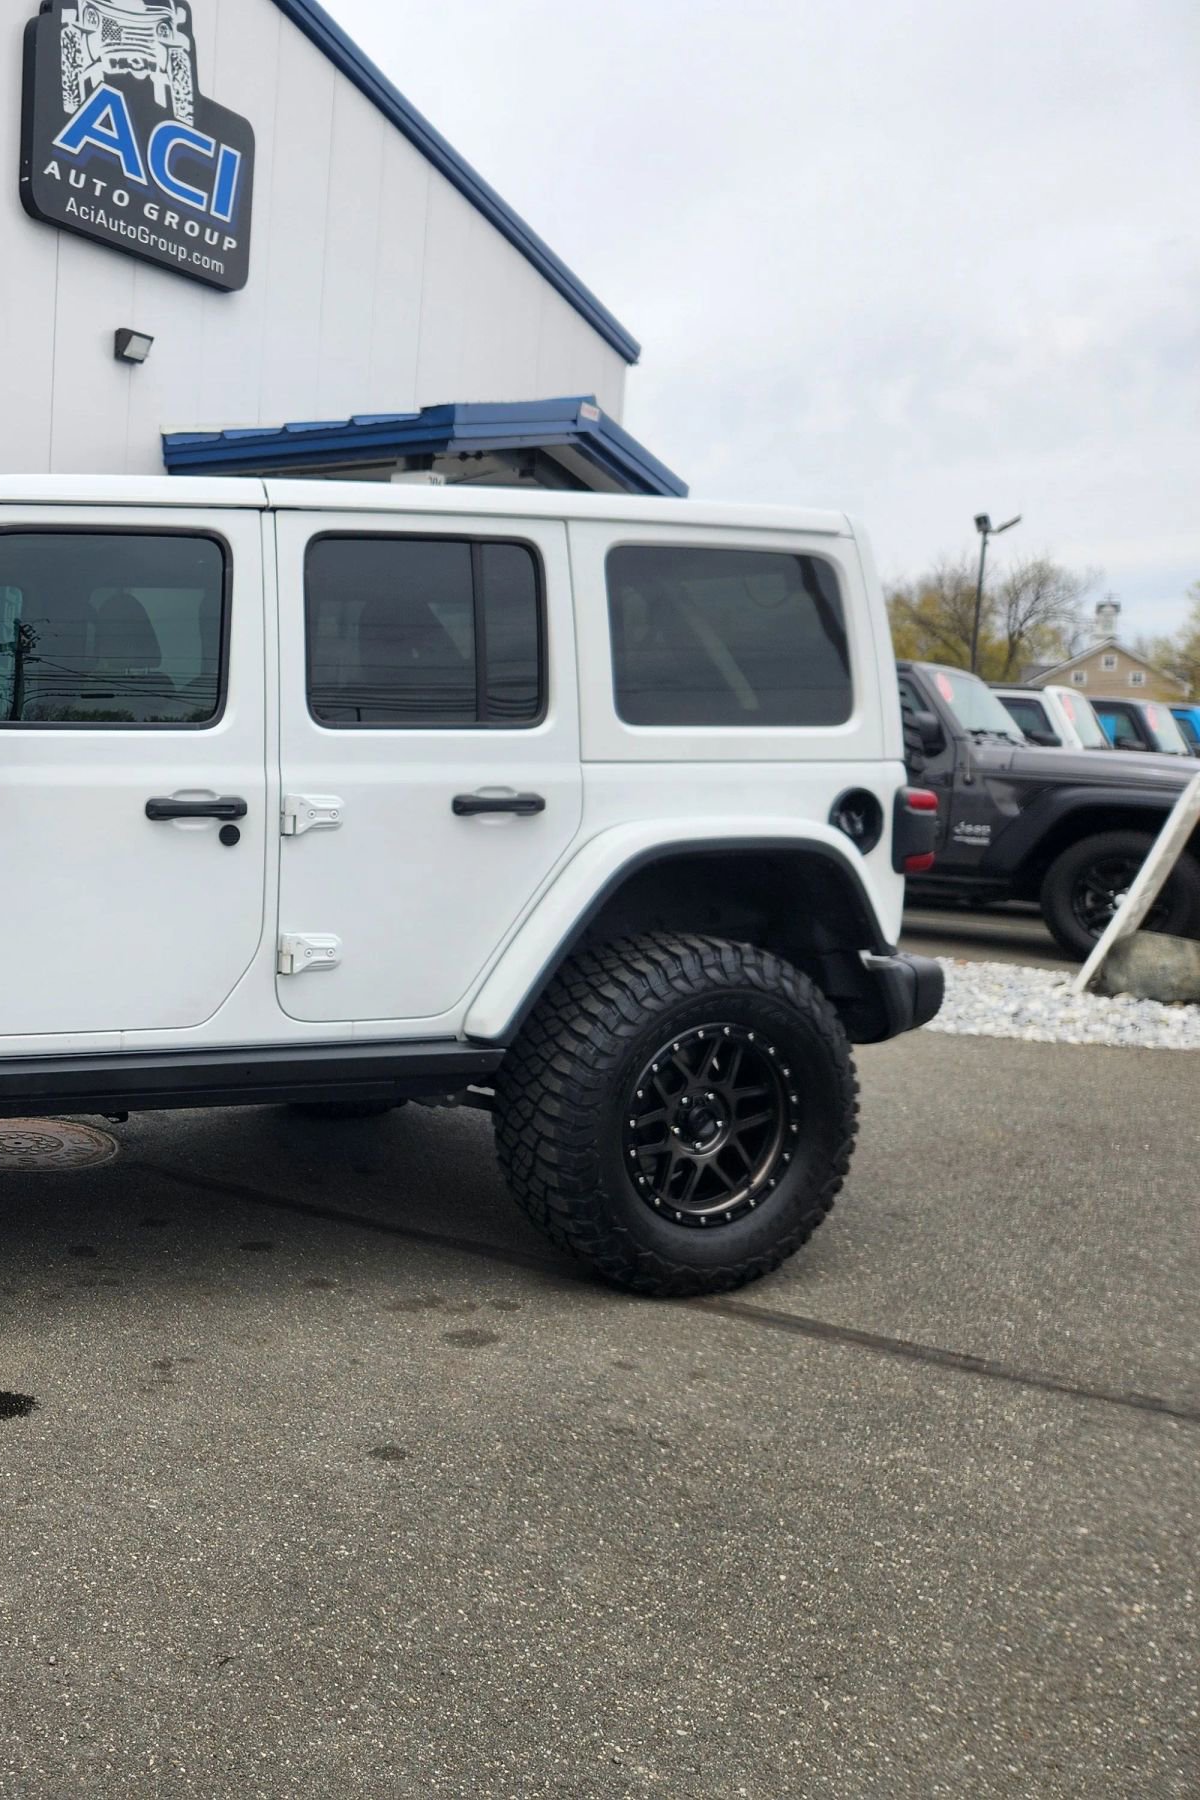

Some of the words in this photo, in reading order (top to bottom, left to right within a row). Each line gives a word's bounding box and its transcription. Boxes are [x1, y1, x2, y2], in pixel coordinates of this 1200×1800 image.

[52, 83, 241, 223] ACI
[43, 161, 130, 207] AUTO
[144, 202, 238, 252] GROUP
[66, 197, 224, 275] AciAutoGroup.com
